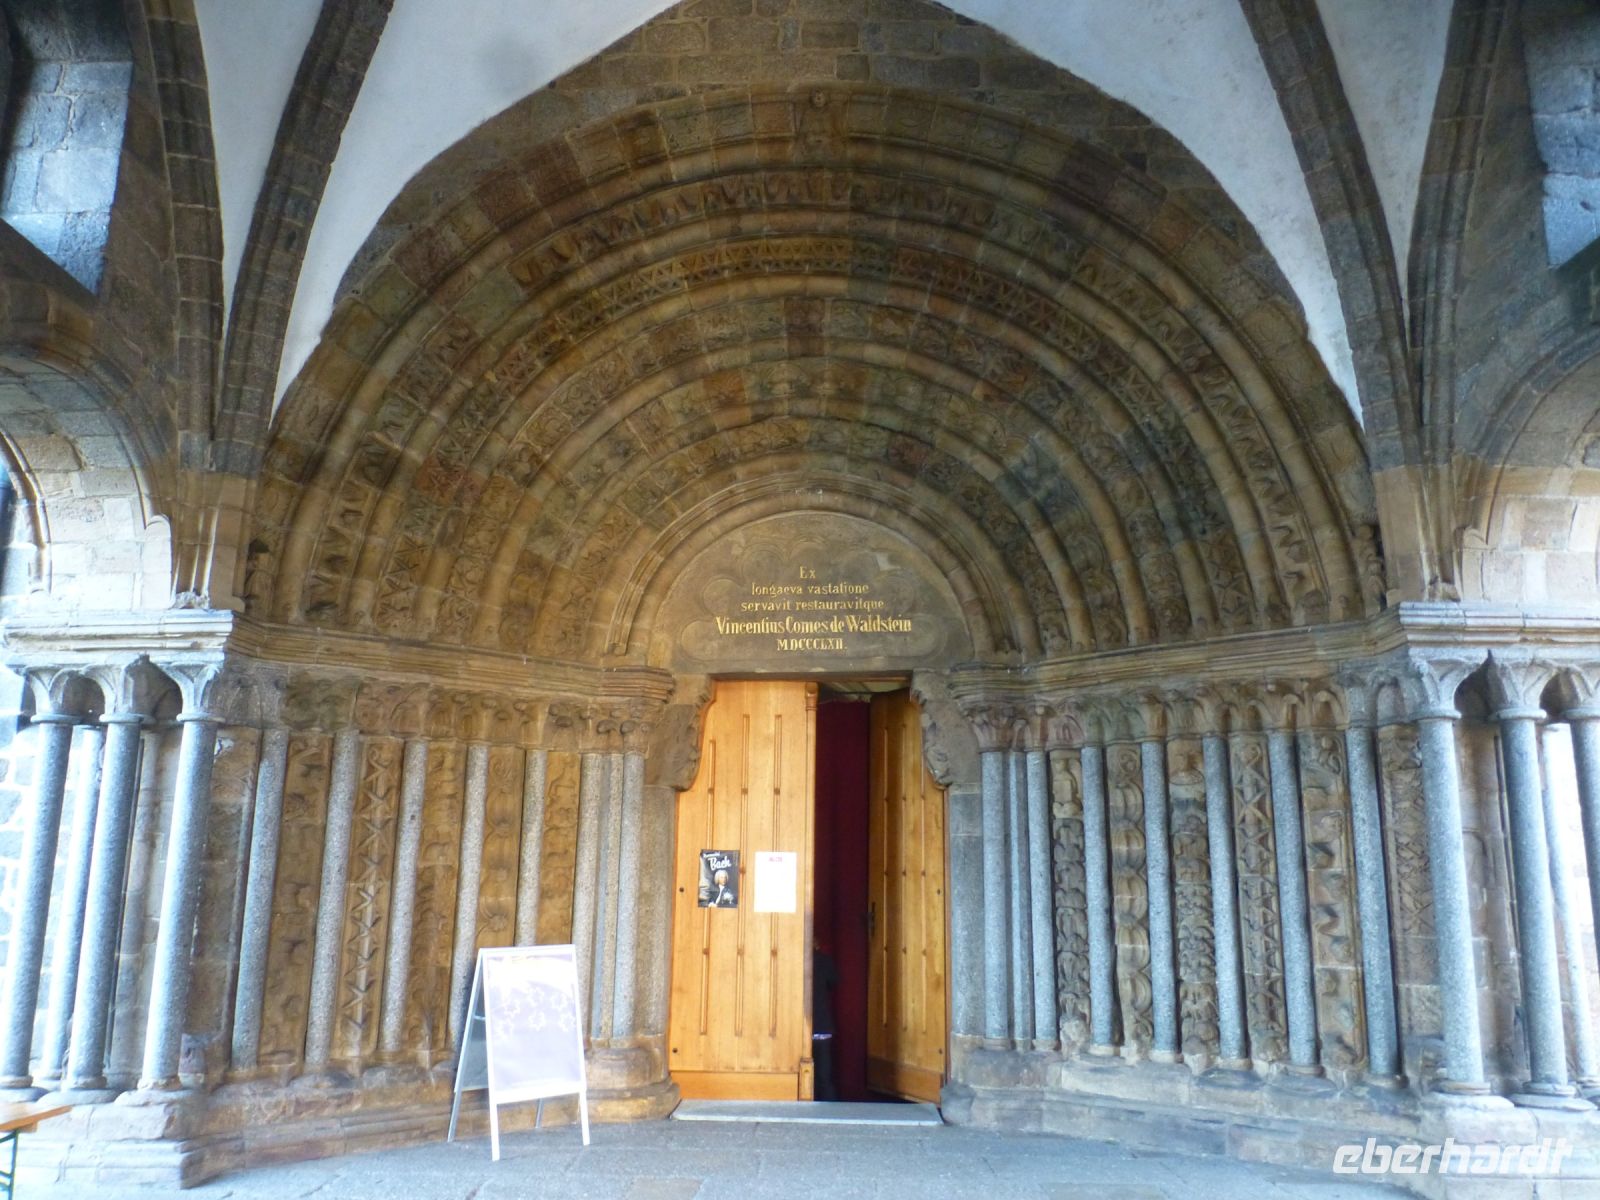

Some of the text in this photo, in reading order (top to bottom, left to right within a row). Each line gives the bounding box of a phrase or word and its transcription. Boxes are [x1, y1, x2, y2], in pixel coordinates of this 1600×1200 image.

[799, 566, 816, 579] Ex
[751, 581, 870, 598] longaeva vastatione
[740, 596, 885, 613] servavit restauravitque
[716, 614, 912, 635] Vincentius Comes de Waldstein
[708, 856, 732, 871] Bach
